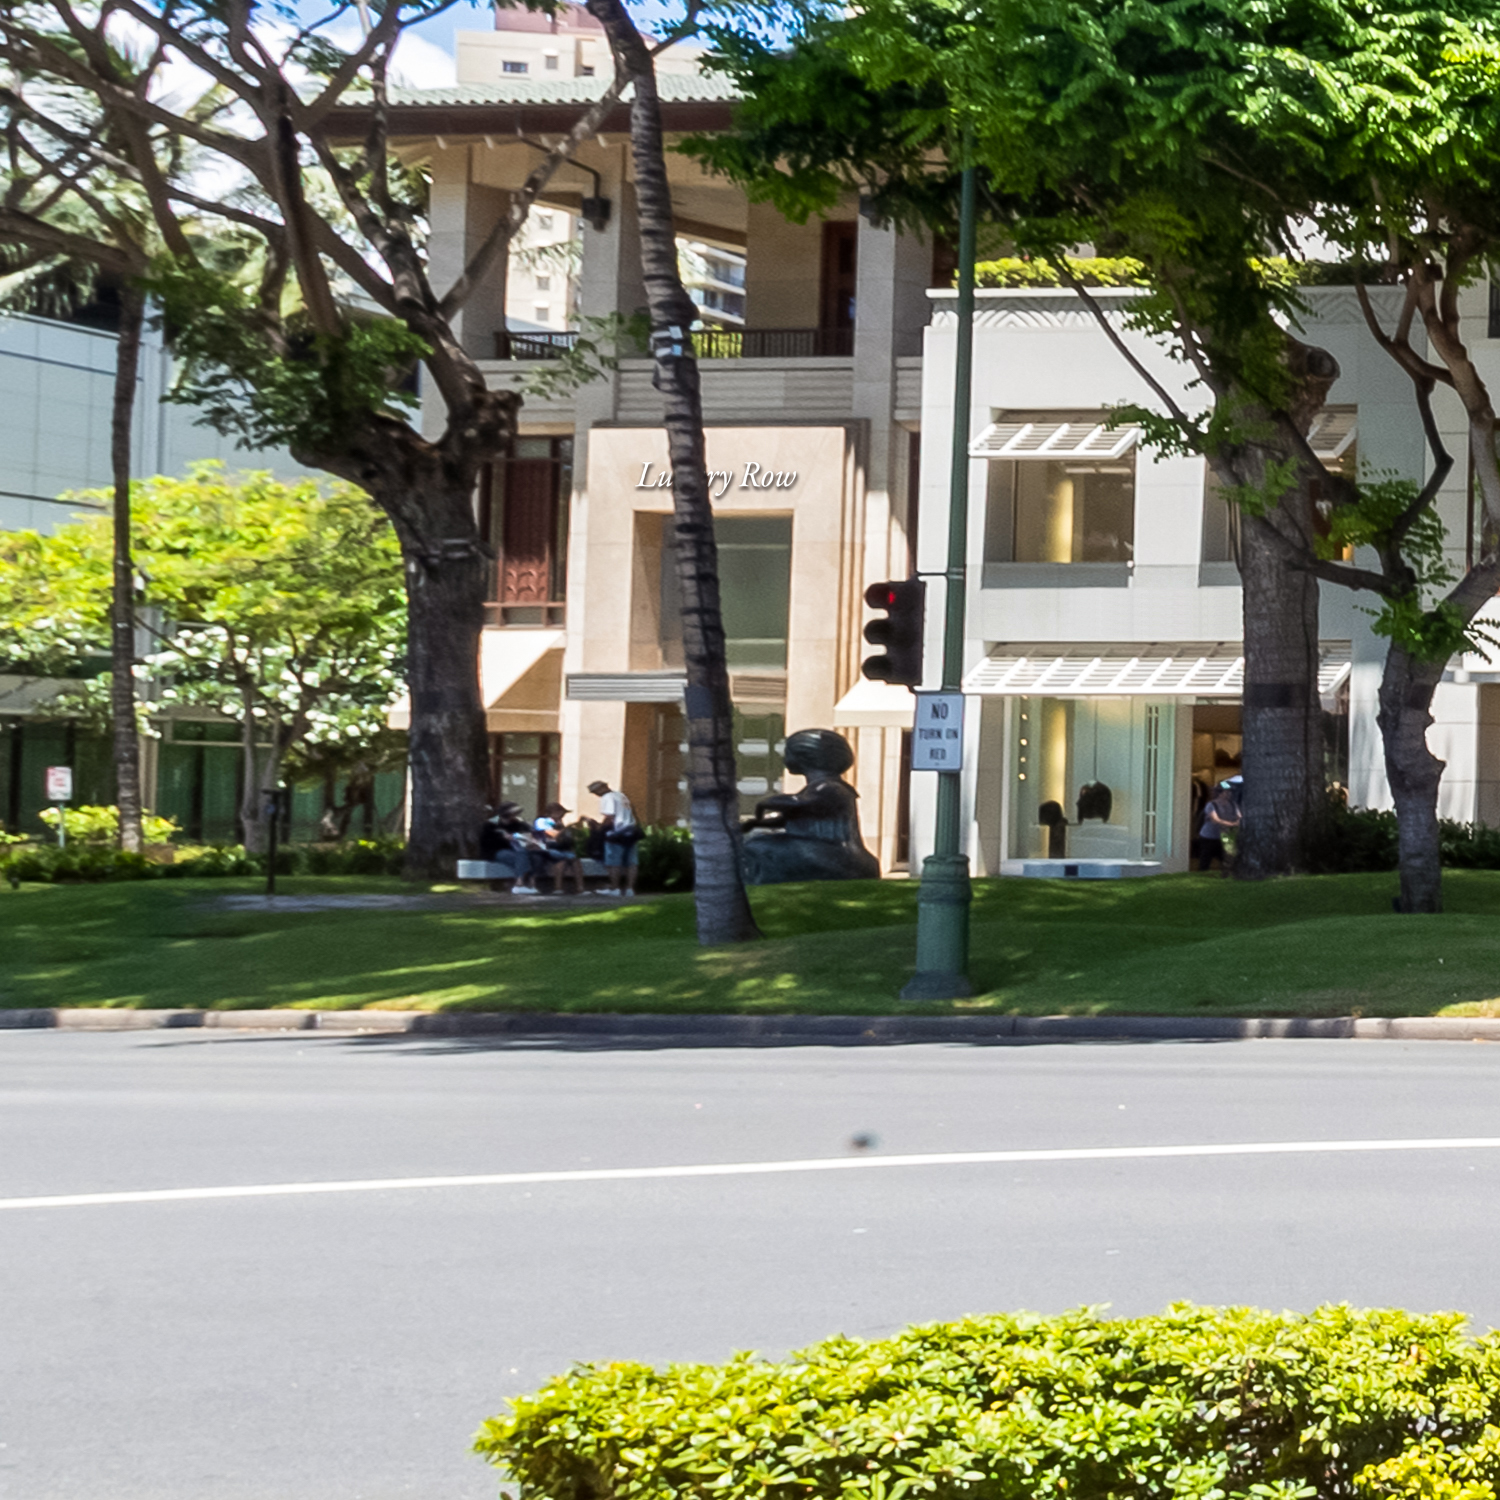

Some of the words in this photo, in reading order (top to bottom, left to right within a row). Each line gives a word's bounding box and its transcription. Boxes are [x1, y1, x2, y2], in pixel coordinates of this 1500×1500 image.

[635, 461, 733, 497] Lury
[739, 461, 797, 488] Row
[931, 703, 949, 719] NO
[919, 728, 942, 739] TURN
[930, 748, 946, 760] RED
